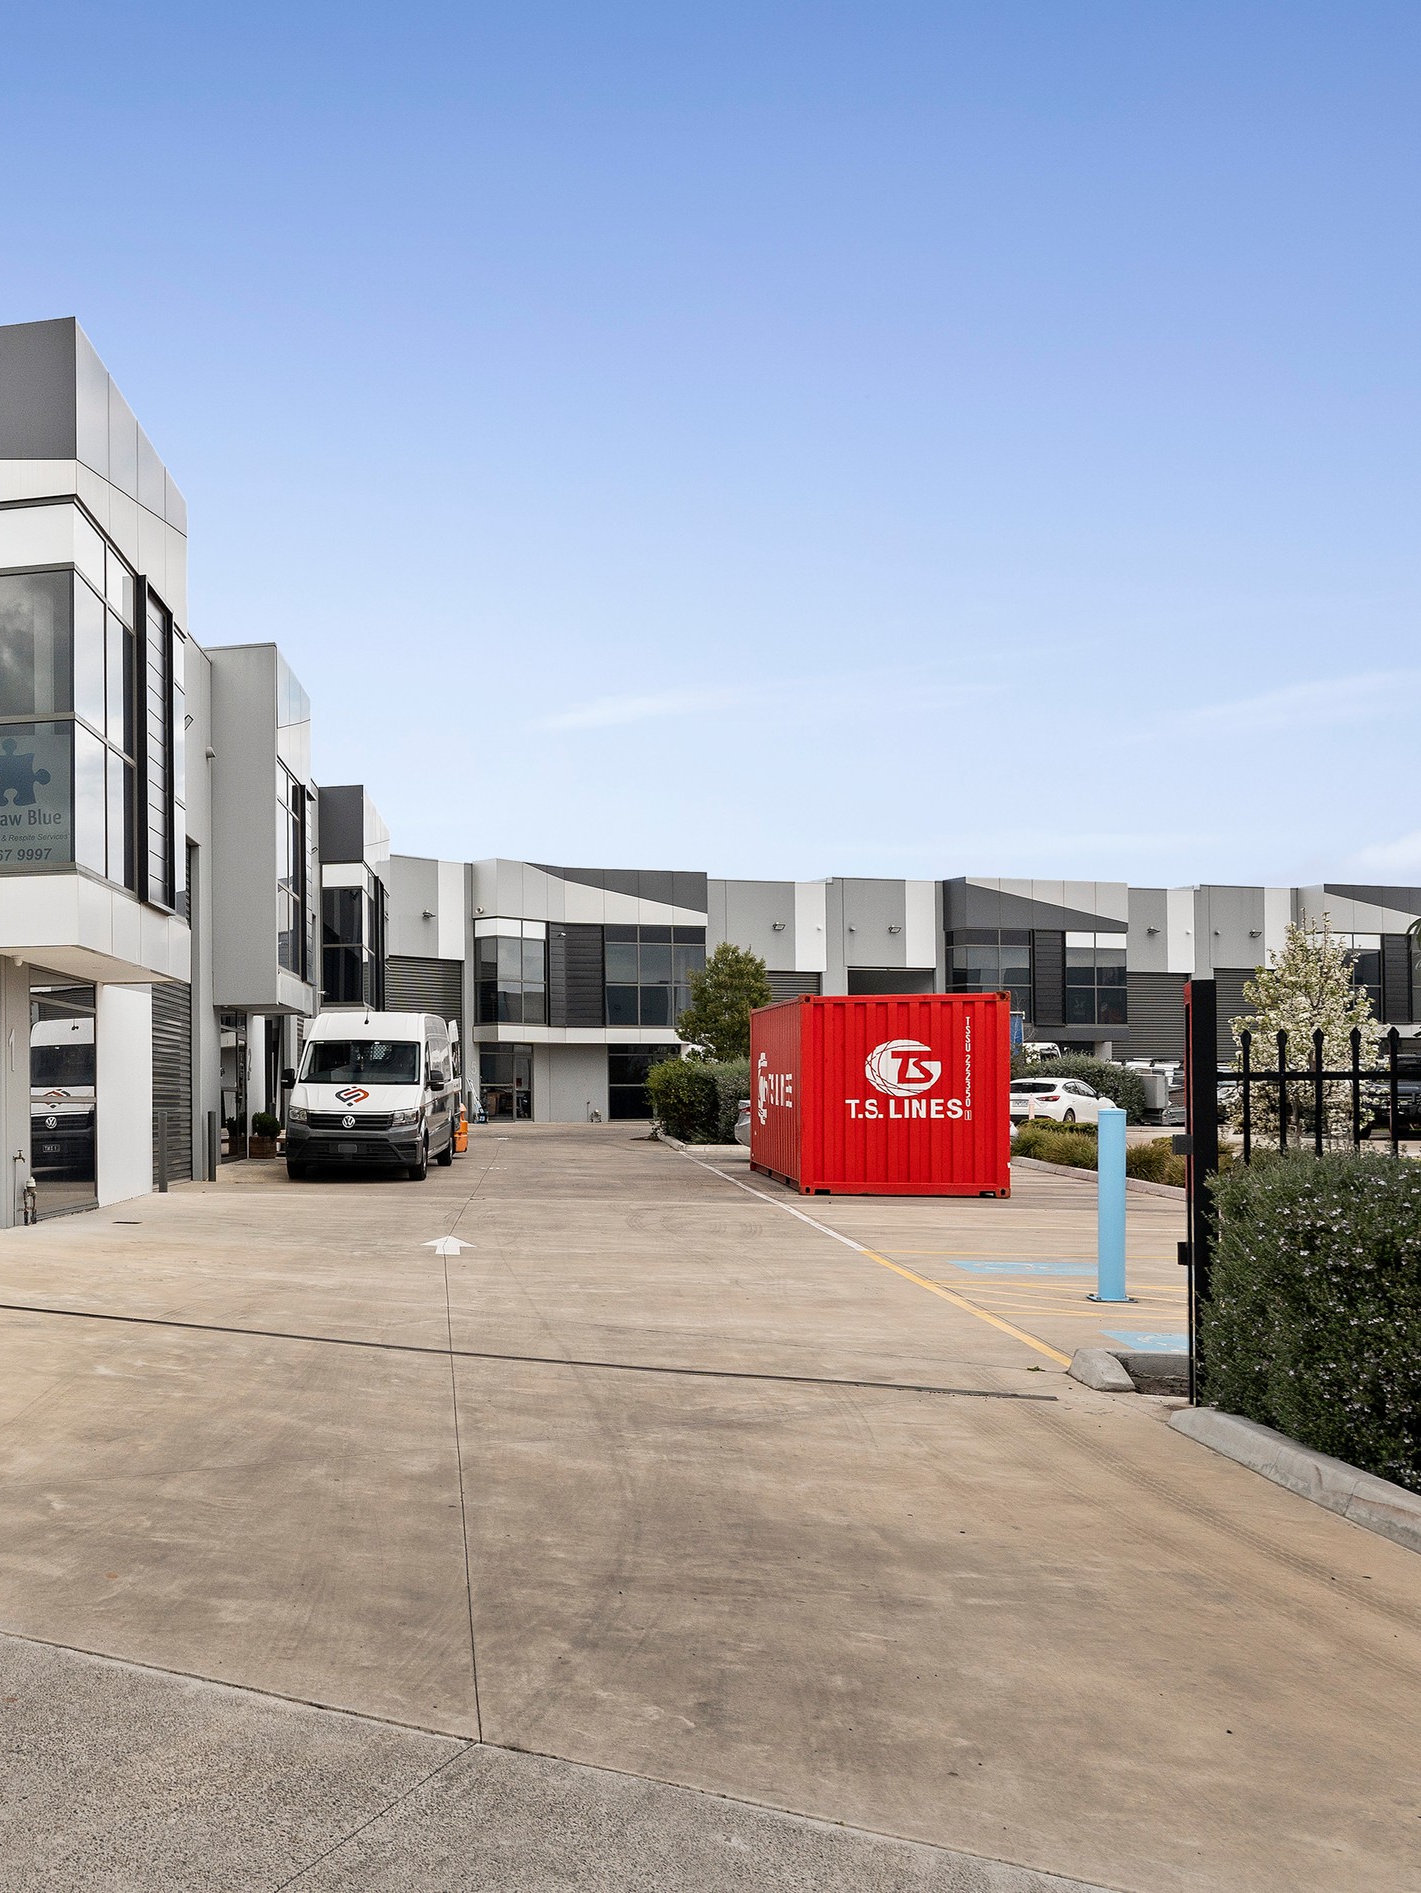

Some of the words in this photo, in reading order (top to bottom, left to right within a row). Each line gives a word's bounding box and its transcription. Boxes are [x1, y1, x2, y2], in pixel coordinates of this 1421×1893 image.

[27, 808, 62, 826] Blue
[1, 834, 7, 842] &
[17, 847, 53, 862] 9997
[8, 1028, 15, 1072] 1
[845, 1098, 884, 1119] T.S.
[889, 1098, 963, 1120] LINES
